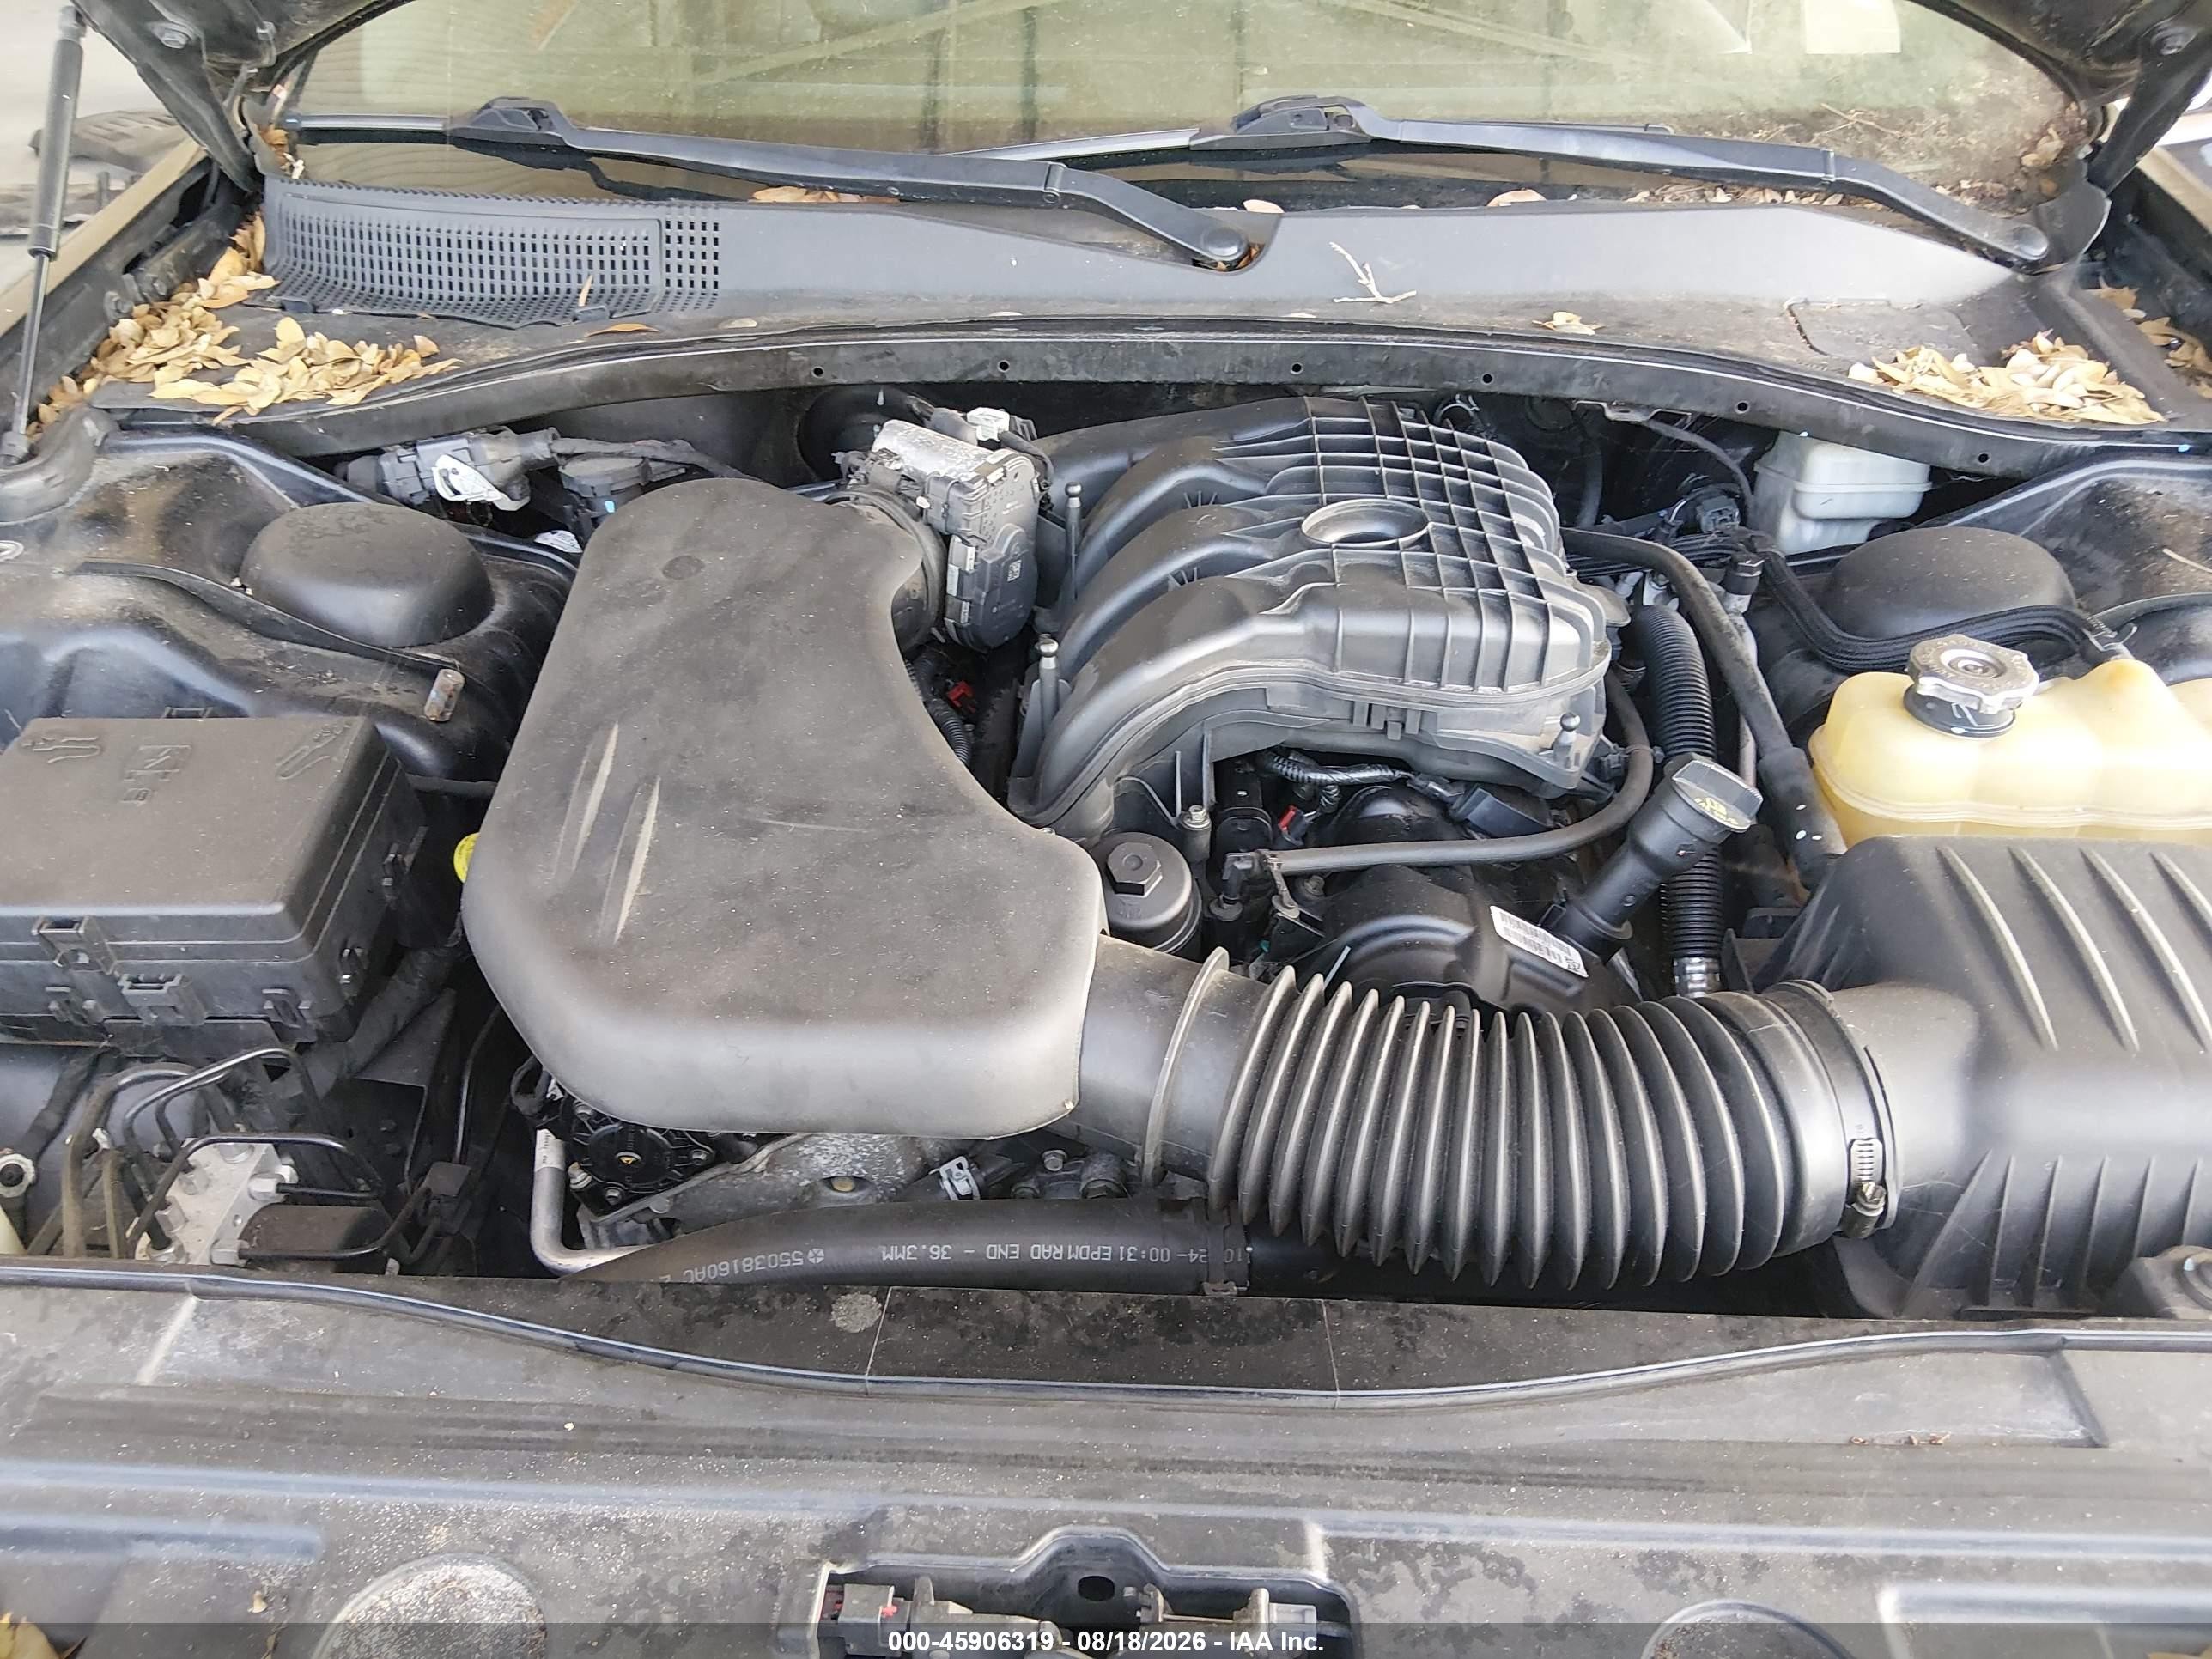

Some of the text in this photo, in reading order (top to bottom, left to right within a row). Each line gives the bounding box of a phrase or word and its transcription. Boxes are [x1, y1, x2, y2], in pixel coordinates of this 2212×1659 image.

[881, 1244, 951, 1261] 36.3MM
[986, 1243, 1020, 1260] END
[1030, 1243, 1065, 1261] RAD
[1067, 1245, 1112, 1261] EPDM
[683, 1249, 804, 1283] 55038160AC
